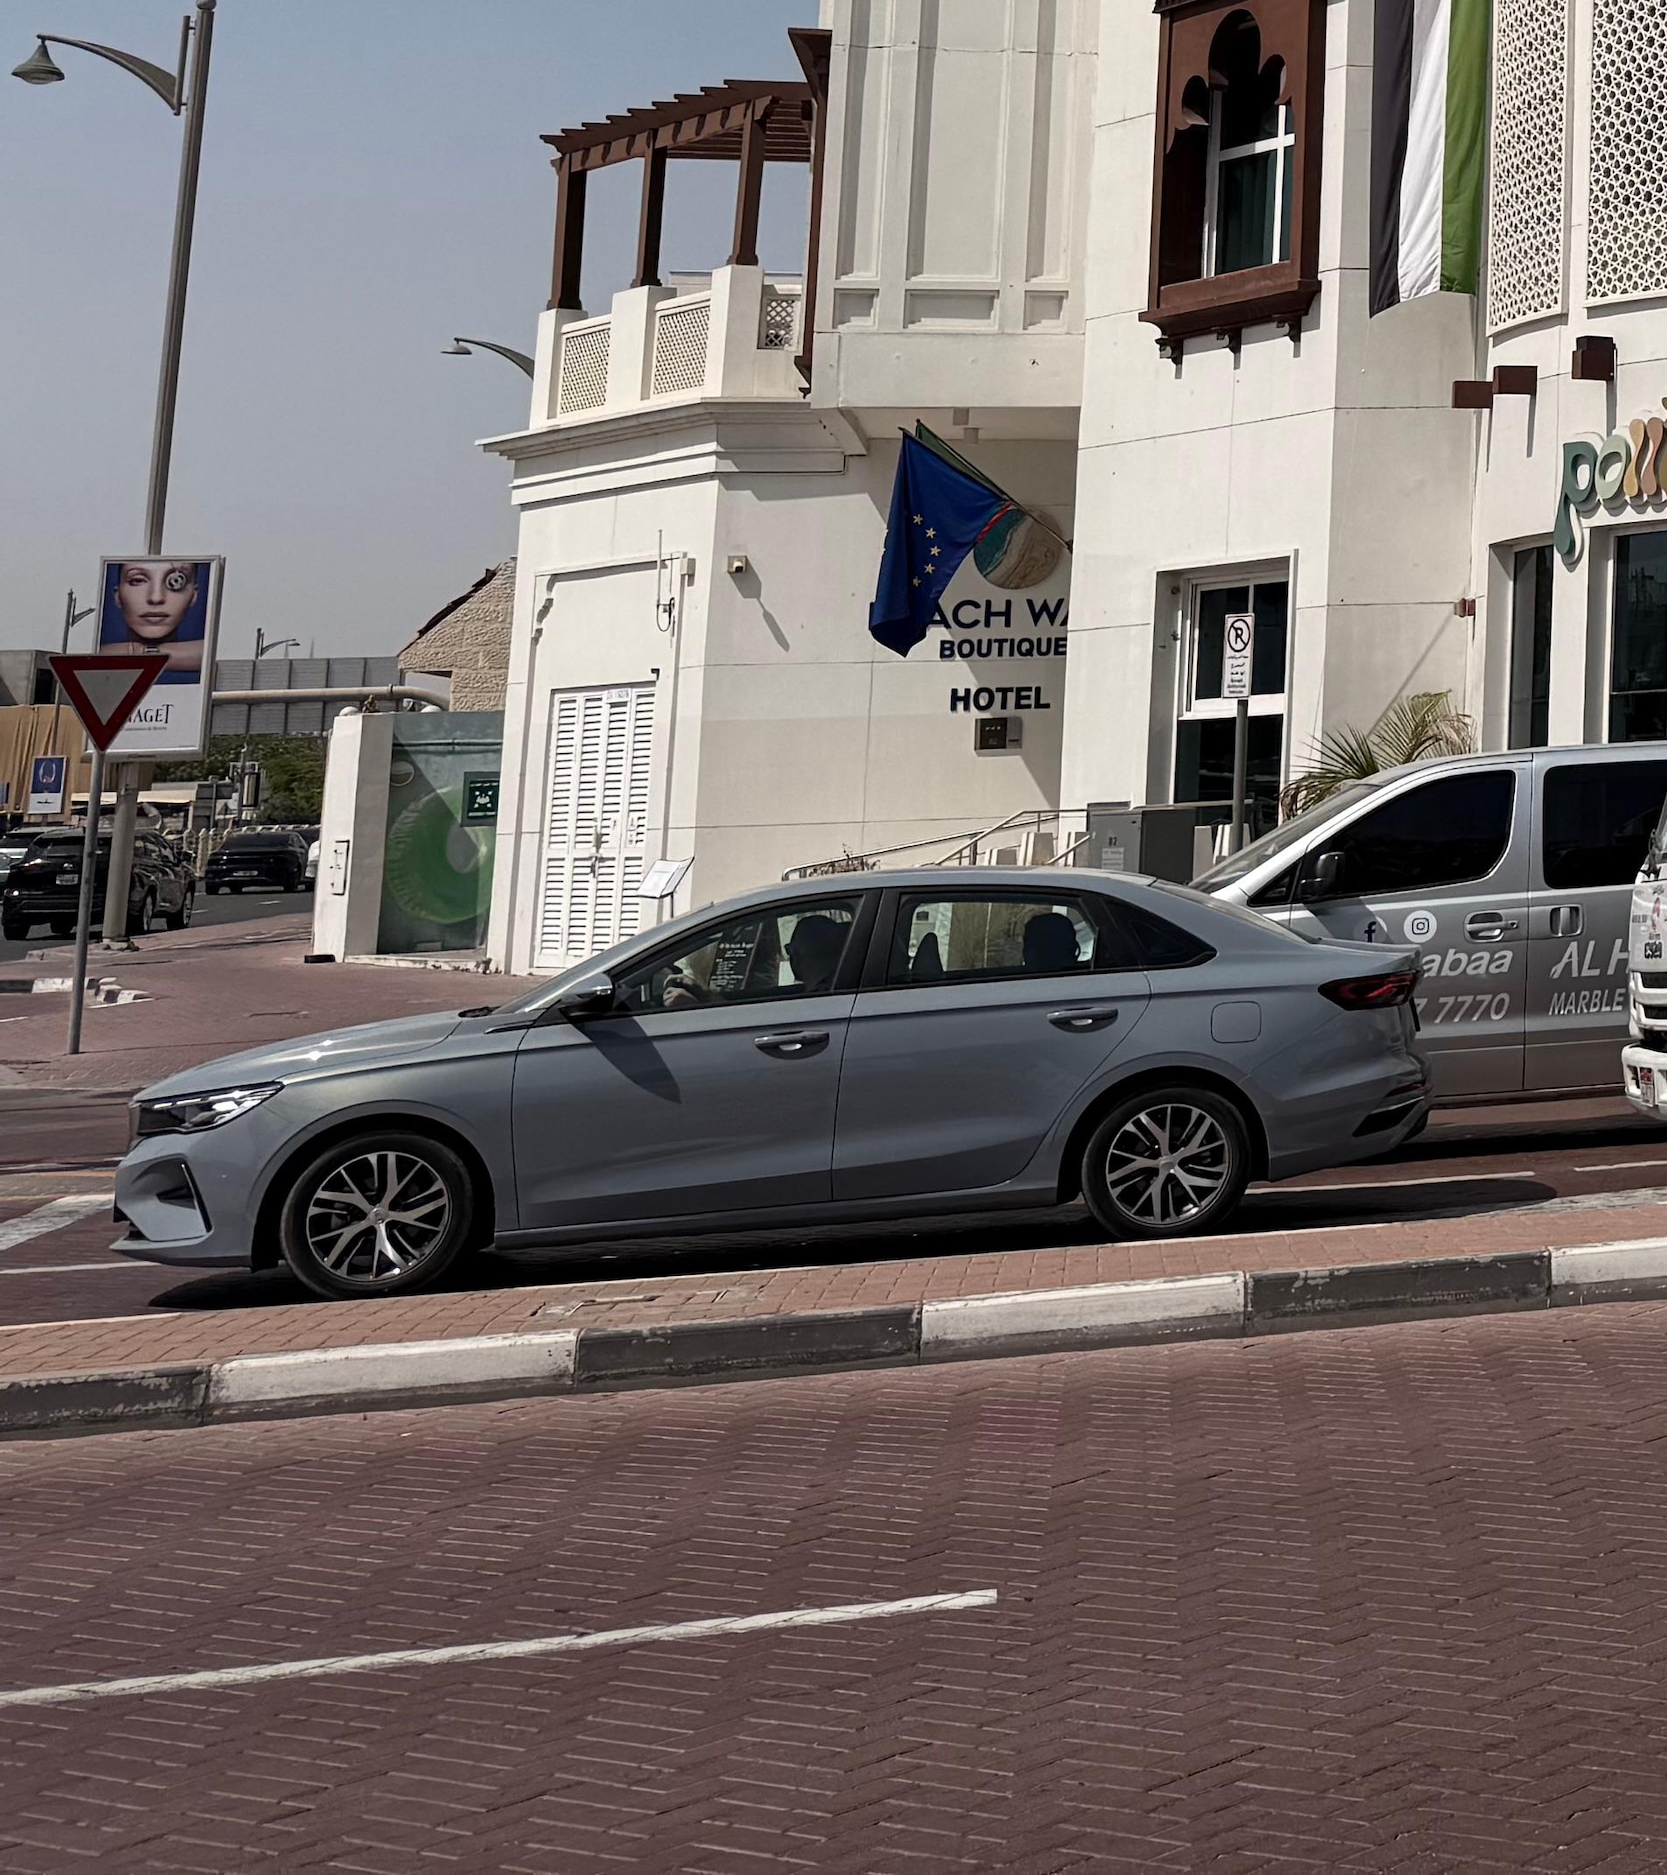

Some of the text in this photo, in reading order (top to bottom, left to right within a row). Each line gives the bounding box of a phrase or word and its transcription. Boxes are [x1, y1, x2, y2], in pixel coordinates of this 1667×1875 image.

[928, 598, 1012, 629] ACH
[939, 636, 1068, 660] BOUTIQUE
[127, 703, 175, 725] AGET
[950, 686, 1051, 712] HOTEL
[1421, 948, 1514, 978] abaa
[1550, 940, 1601, 980] AL
[1434, 992, 1510, 1025] 7770
[1548, 987, 1627, 1017] MARBLE
